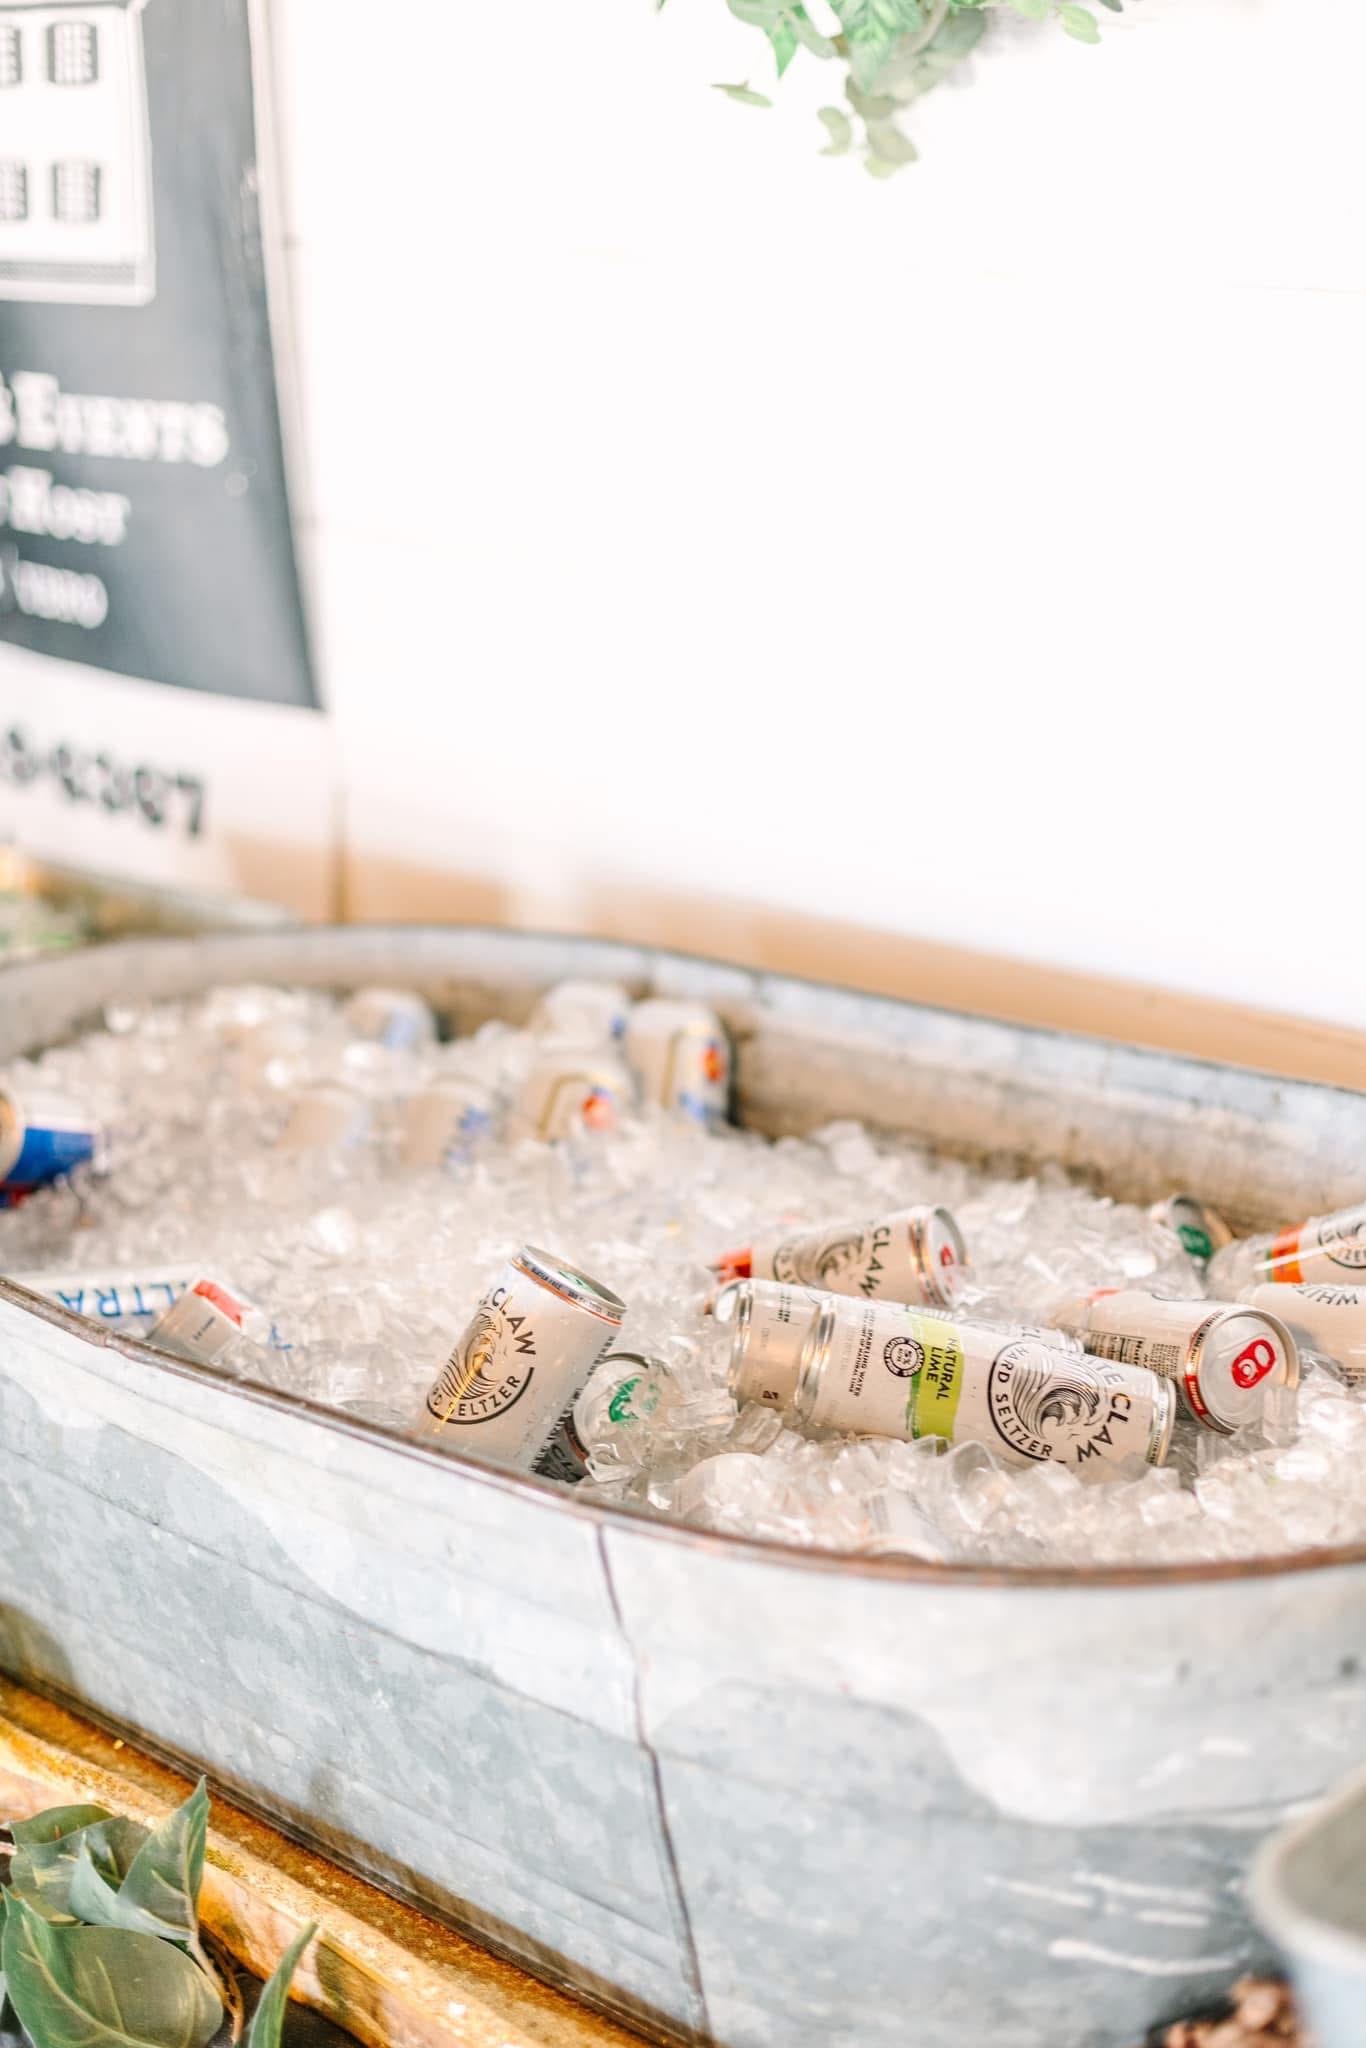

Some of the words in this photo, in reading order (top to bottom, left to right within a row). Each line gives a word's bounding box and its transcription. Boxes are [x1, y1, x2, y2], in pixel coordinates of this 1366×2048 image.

[57, 1281, 188, 1319] LTRA
[926, 1346, 944, 1384] LIME
[936, 1337, 959, 1401] NATURAL
[996, 1346, 1030, 1384] HARD
[995, 1393, 1054, 1457] SELTZER
[1075, 1392, 1132, 1463] CLAW
